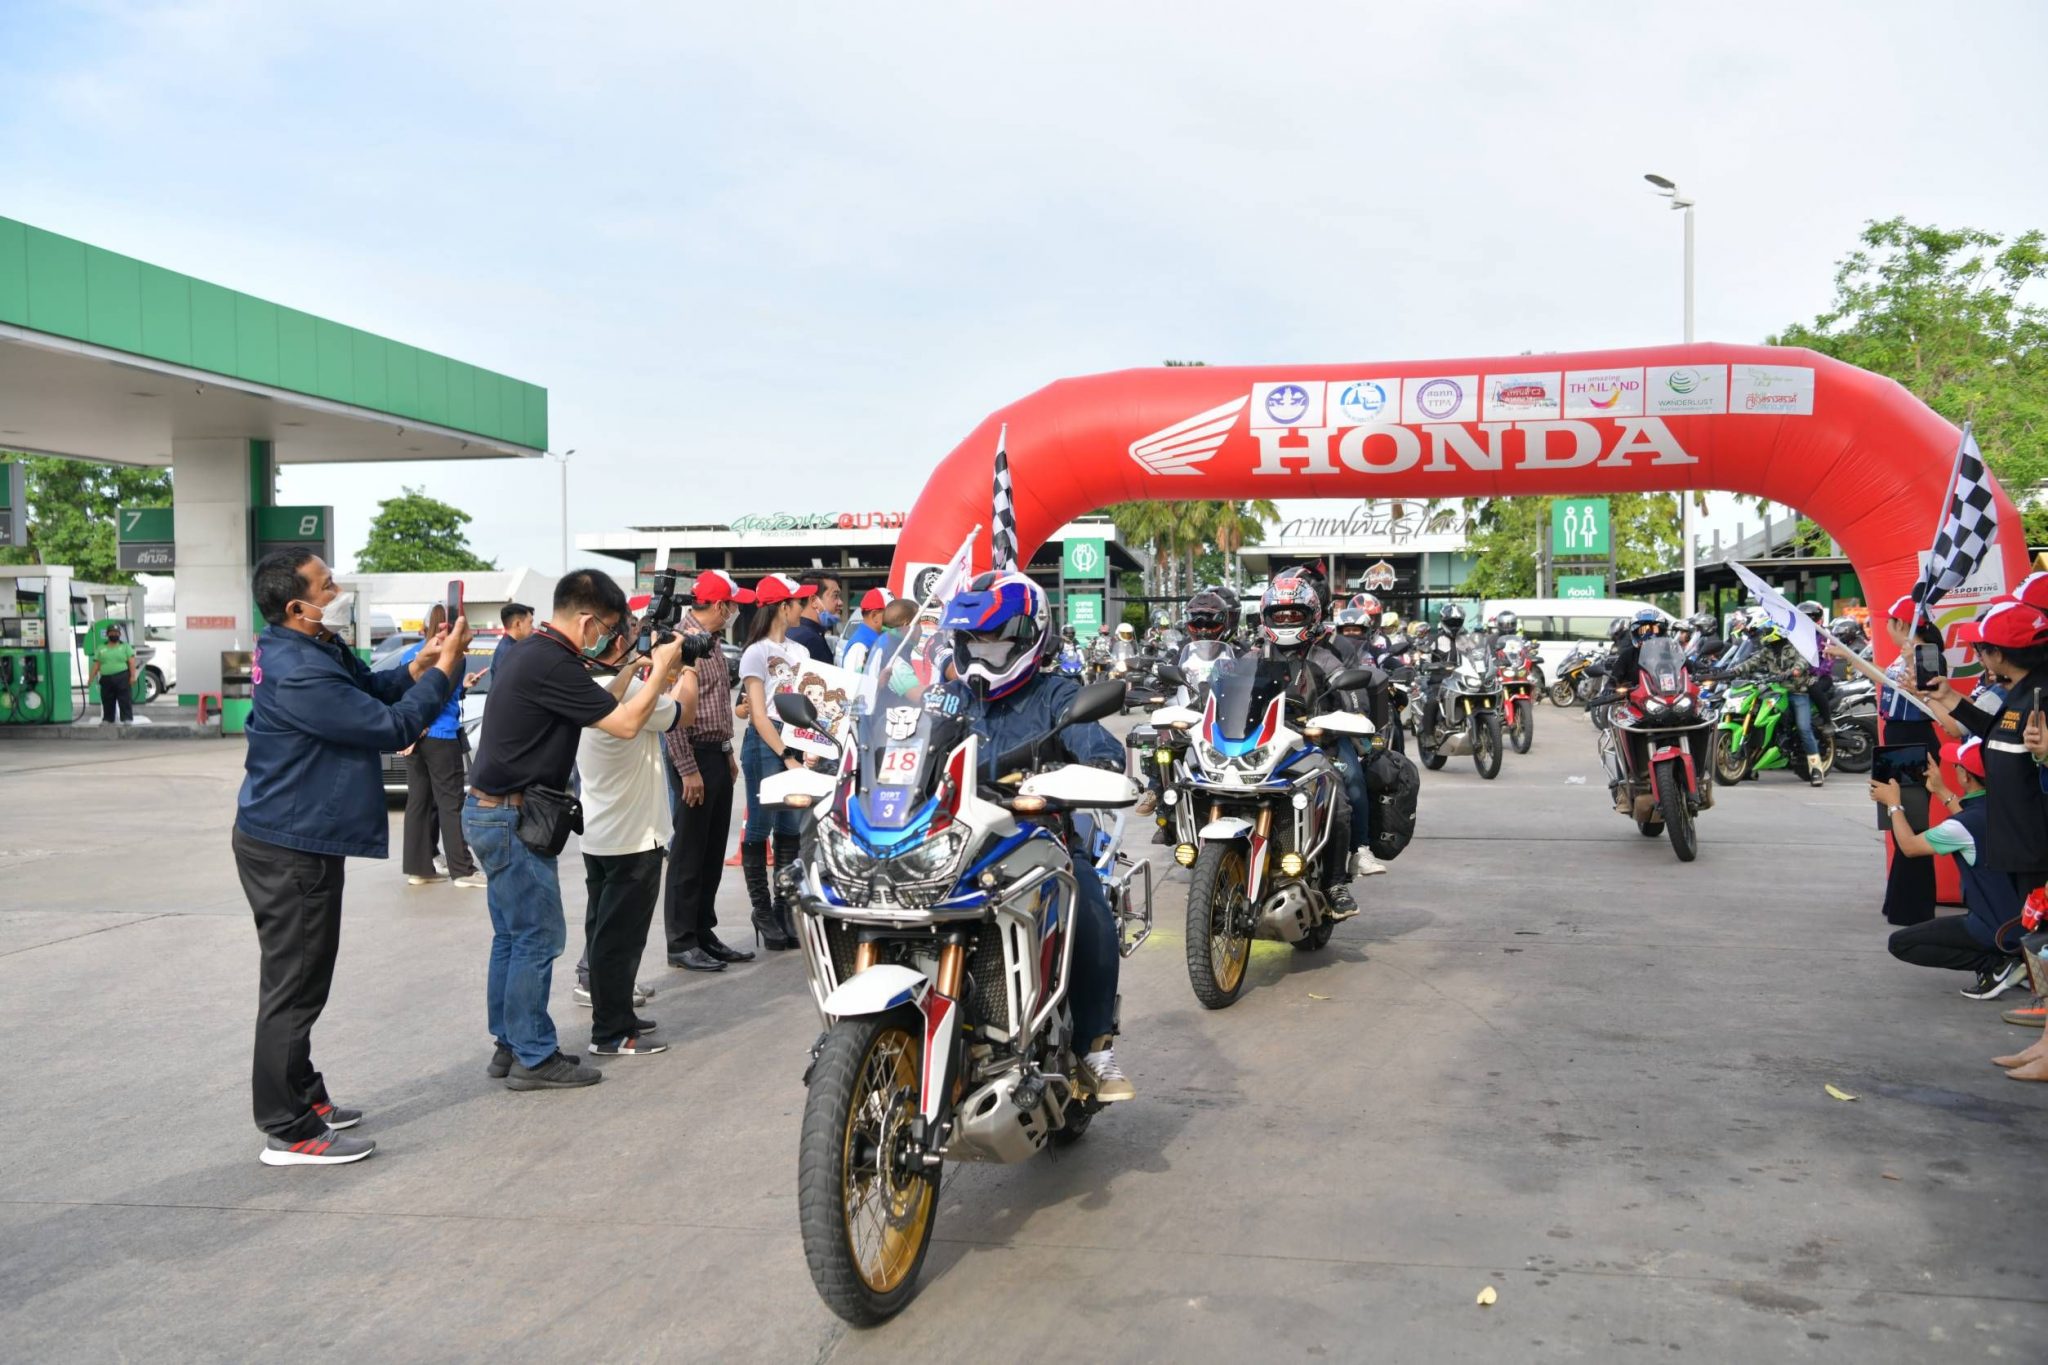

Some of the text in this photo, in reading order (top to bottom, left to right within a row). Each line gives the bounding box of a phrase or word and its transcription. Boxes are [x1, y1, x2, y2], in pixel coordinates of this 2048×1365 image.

[1570, 381, 1640, 393] THAILAND
[1428, 399, 1451, 407] TTPA
[1658, 398, 1714, 407] WANDERLUST
[1251, 418, 1698, 475] HONDA
[126, 512, 142, 532] 7
[299, 515, 318, 535] 8
[838, 512, 905, 530] @บาง
[885, 752, 916, 771] 18
[883, 804, 894, 818] 3
